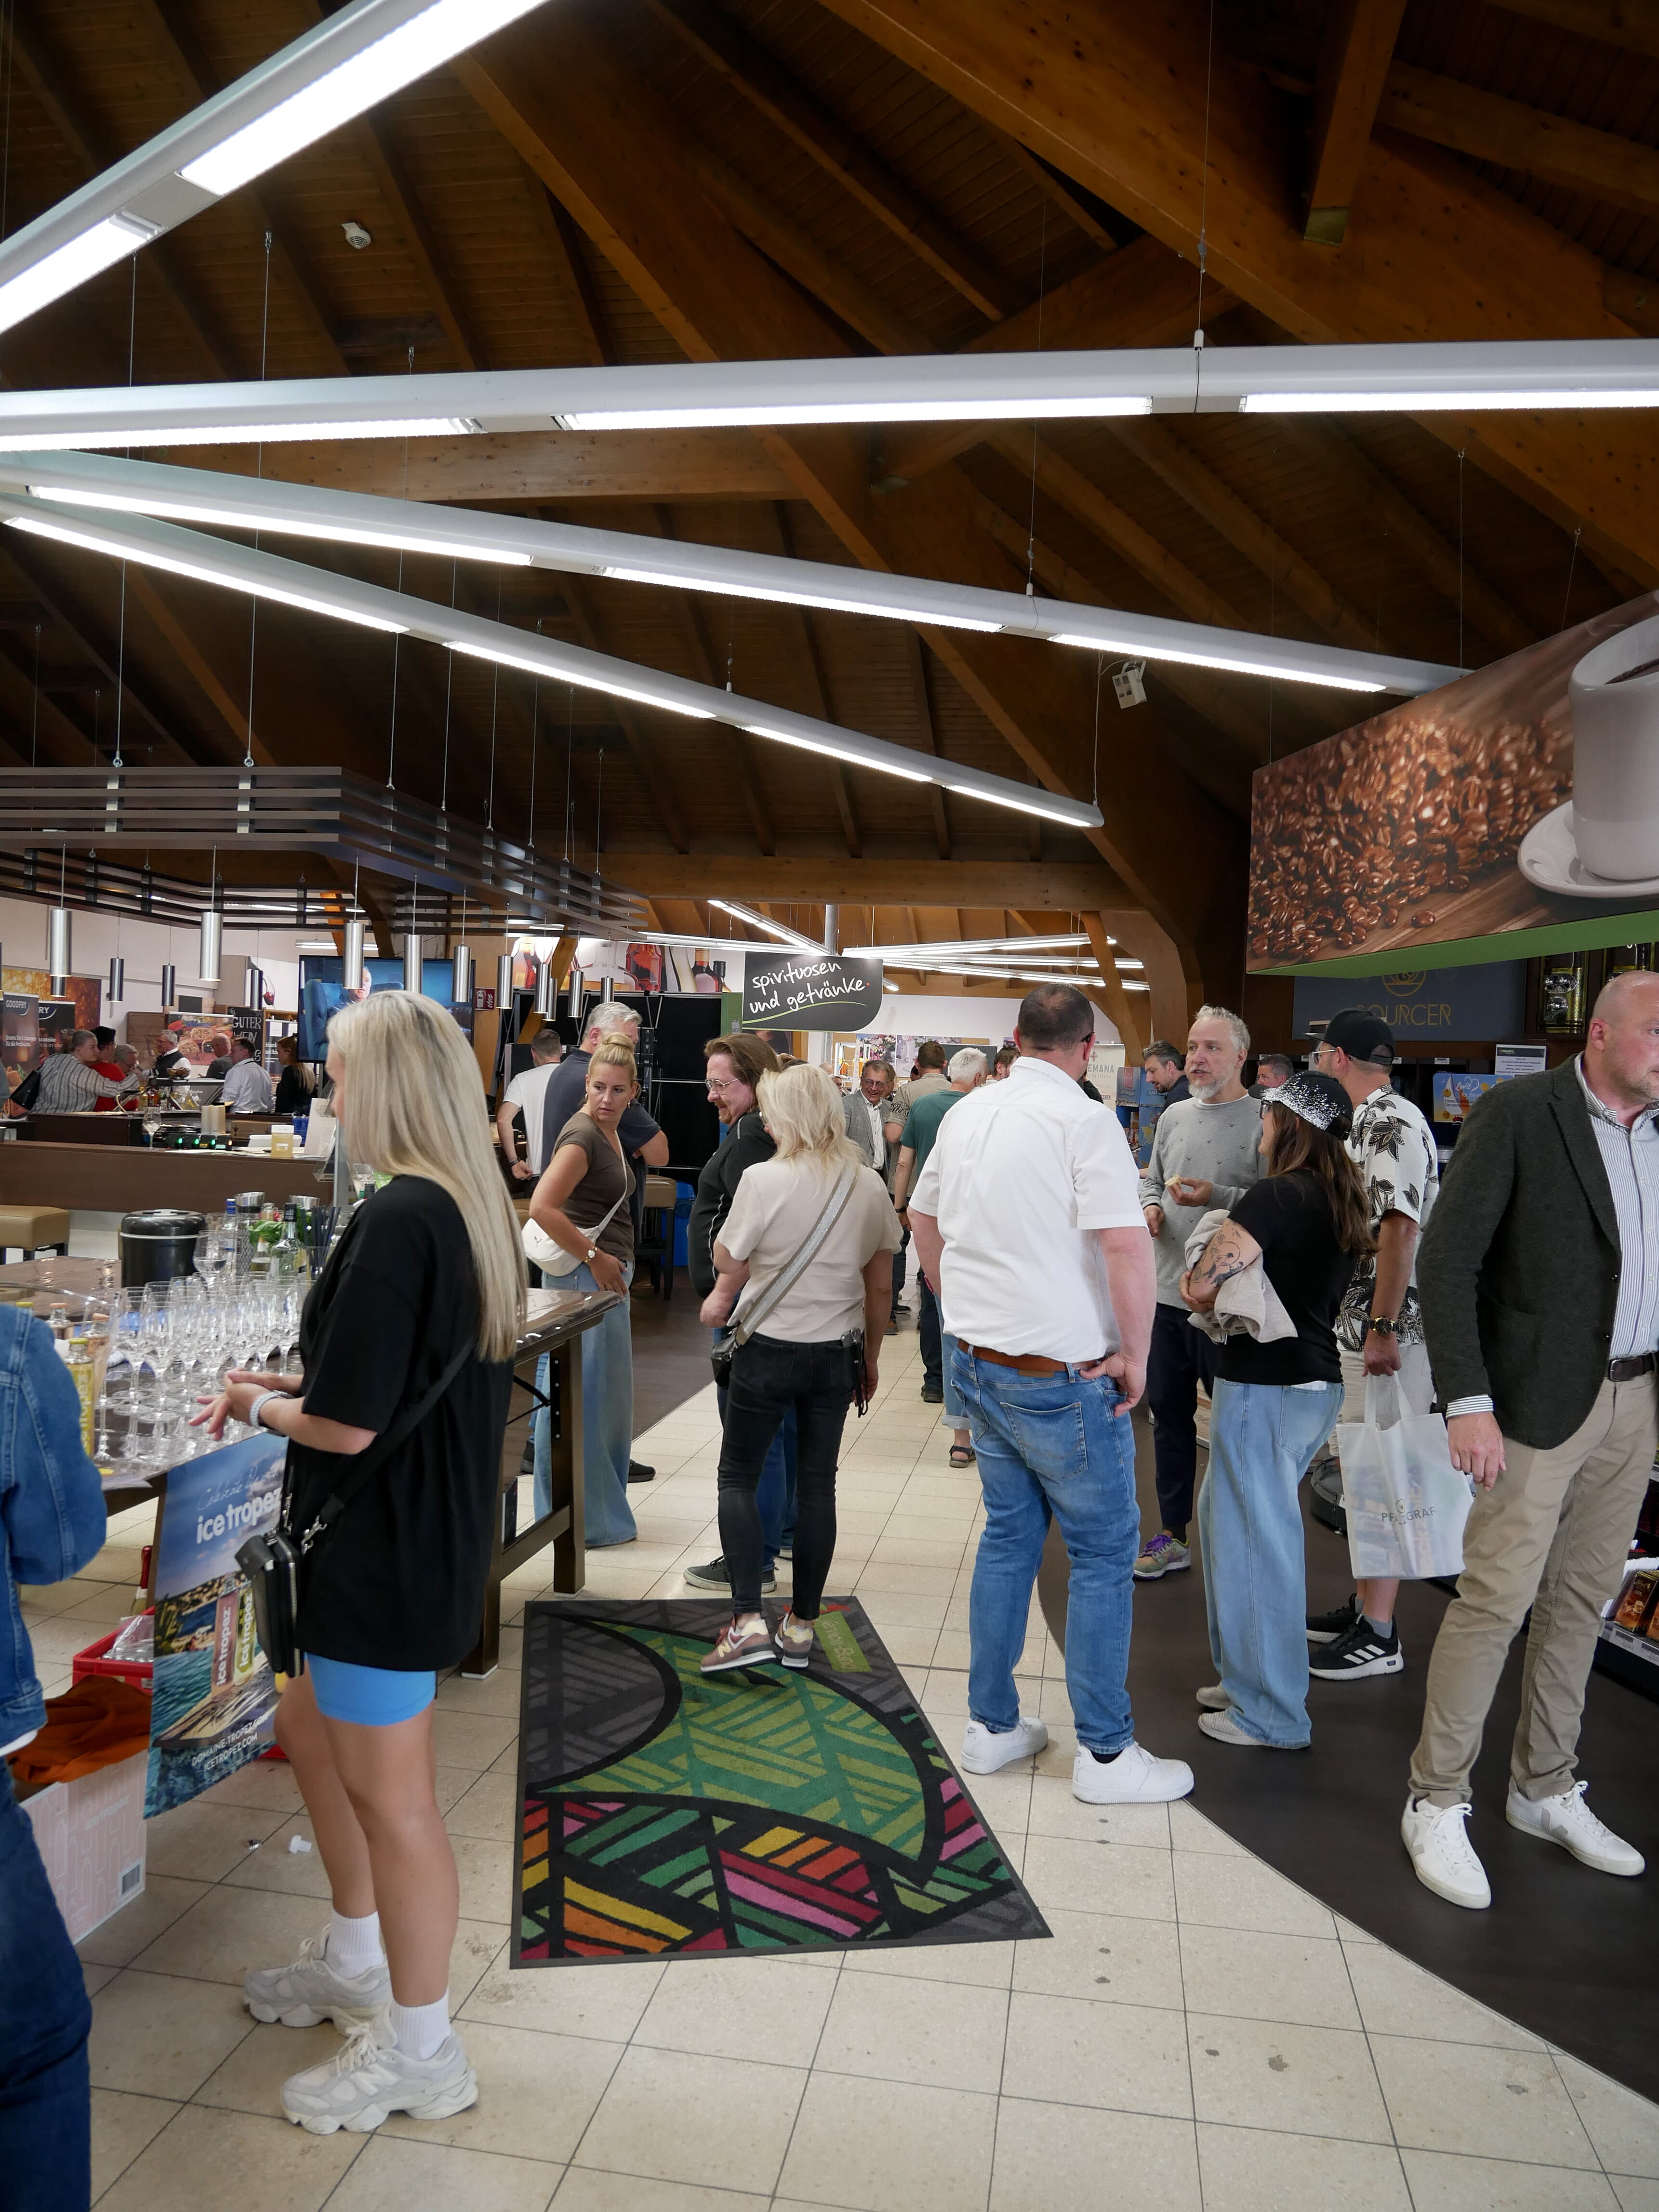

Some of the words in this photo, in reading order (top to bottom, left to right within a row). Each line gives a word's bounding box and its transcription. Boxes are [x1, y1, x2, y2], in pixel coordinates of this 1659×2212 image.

[752, 962, 841, 995] spirituosen
[6, 1000, 27, 1009] GOODFRY
[749, 991, 781, 1014] und
[232, 1016, 262, 1030] GUTER
